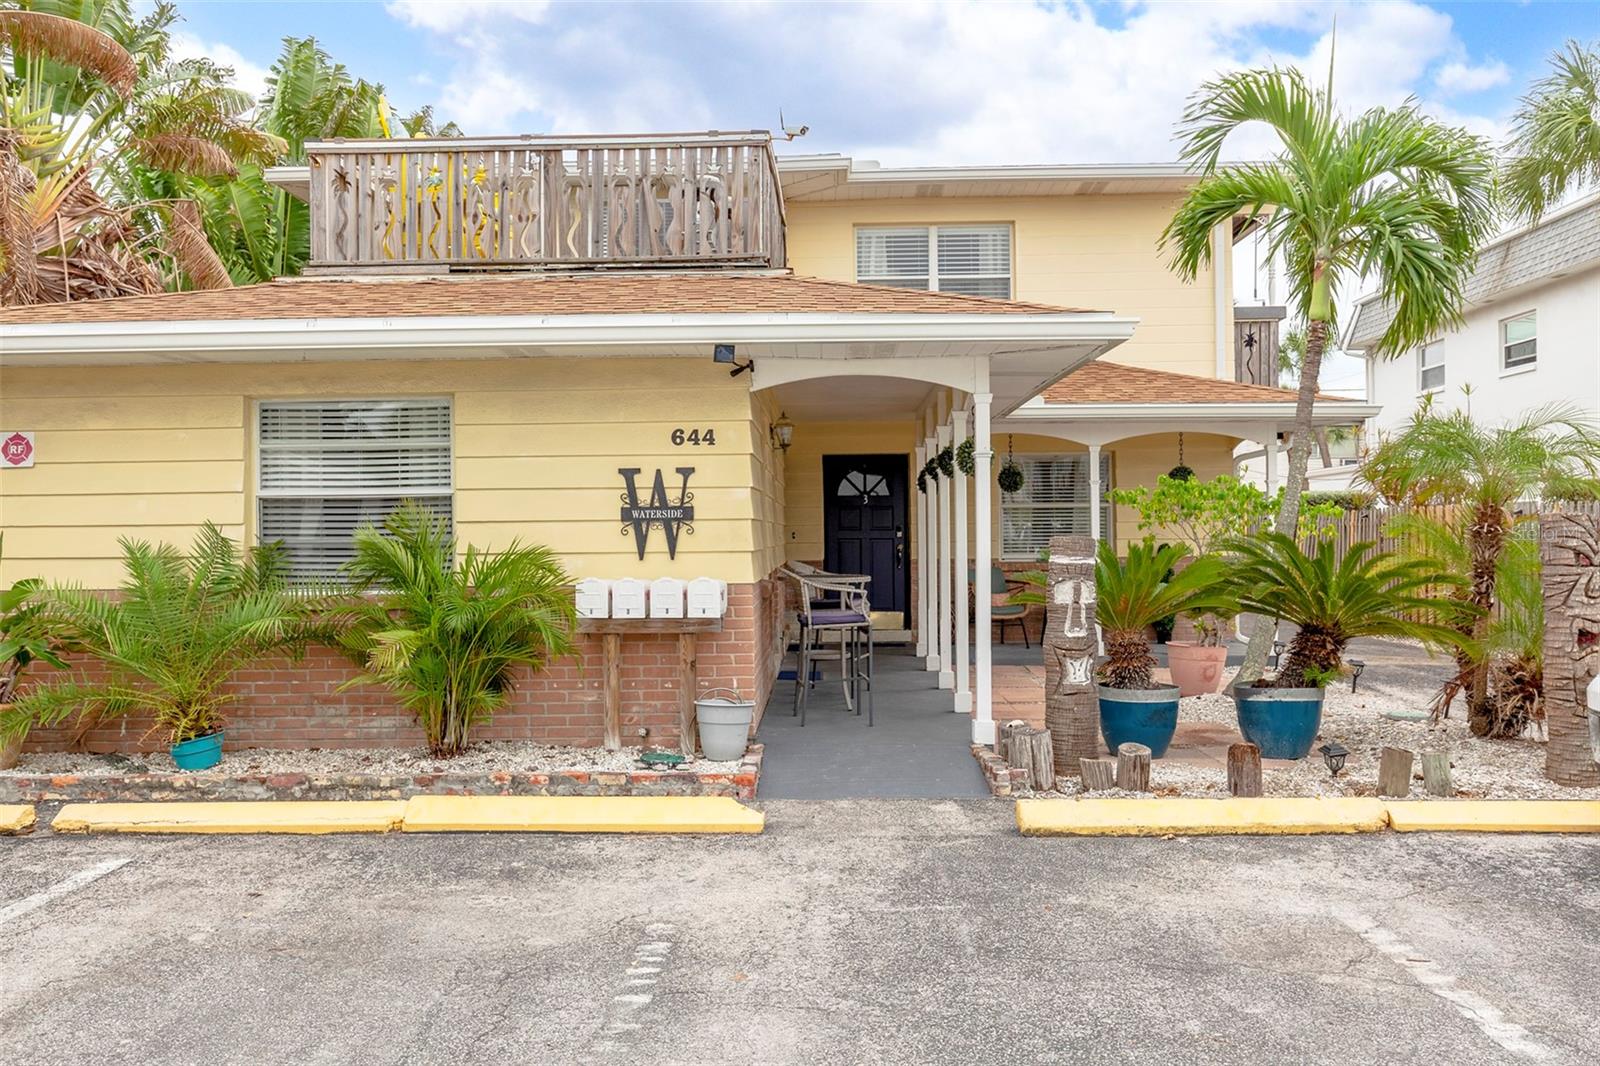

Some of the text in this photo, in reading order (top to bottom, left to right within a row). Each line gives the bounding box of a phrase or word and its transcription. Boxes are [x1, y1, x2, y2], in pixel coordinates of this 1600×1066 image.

[671, 428, 716, 446] 644
[10, 445, 24, 454] RF
[863, 494, 869, 504] 3
[618, 467, 696, 561] W
[632, 509, 683, 519] WATERSIDE
